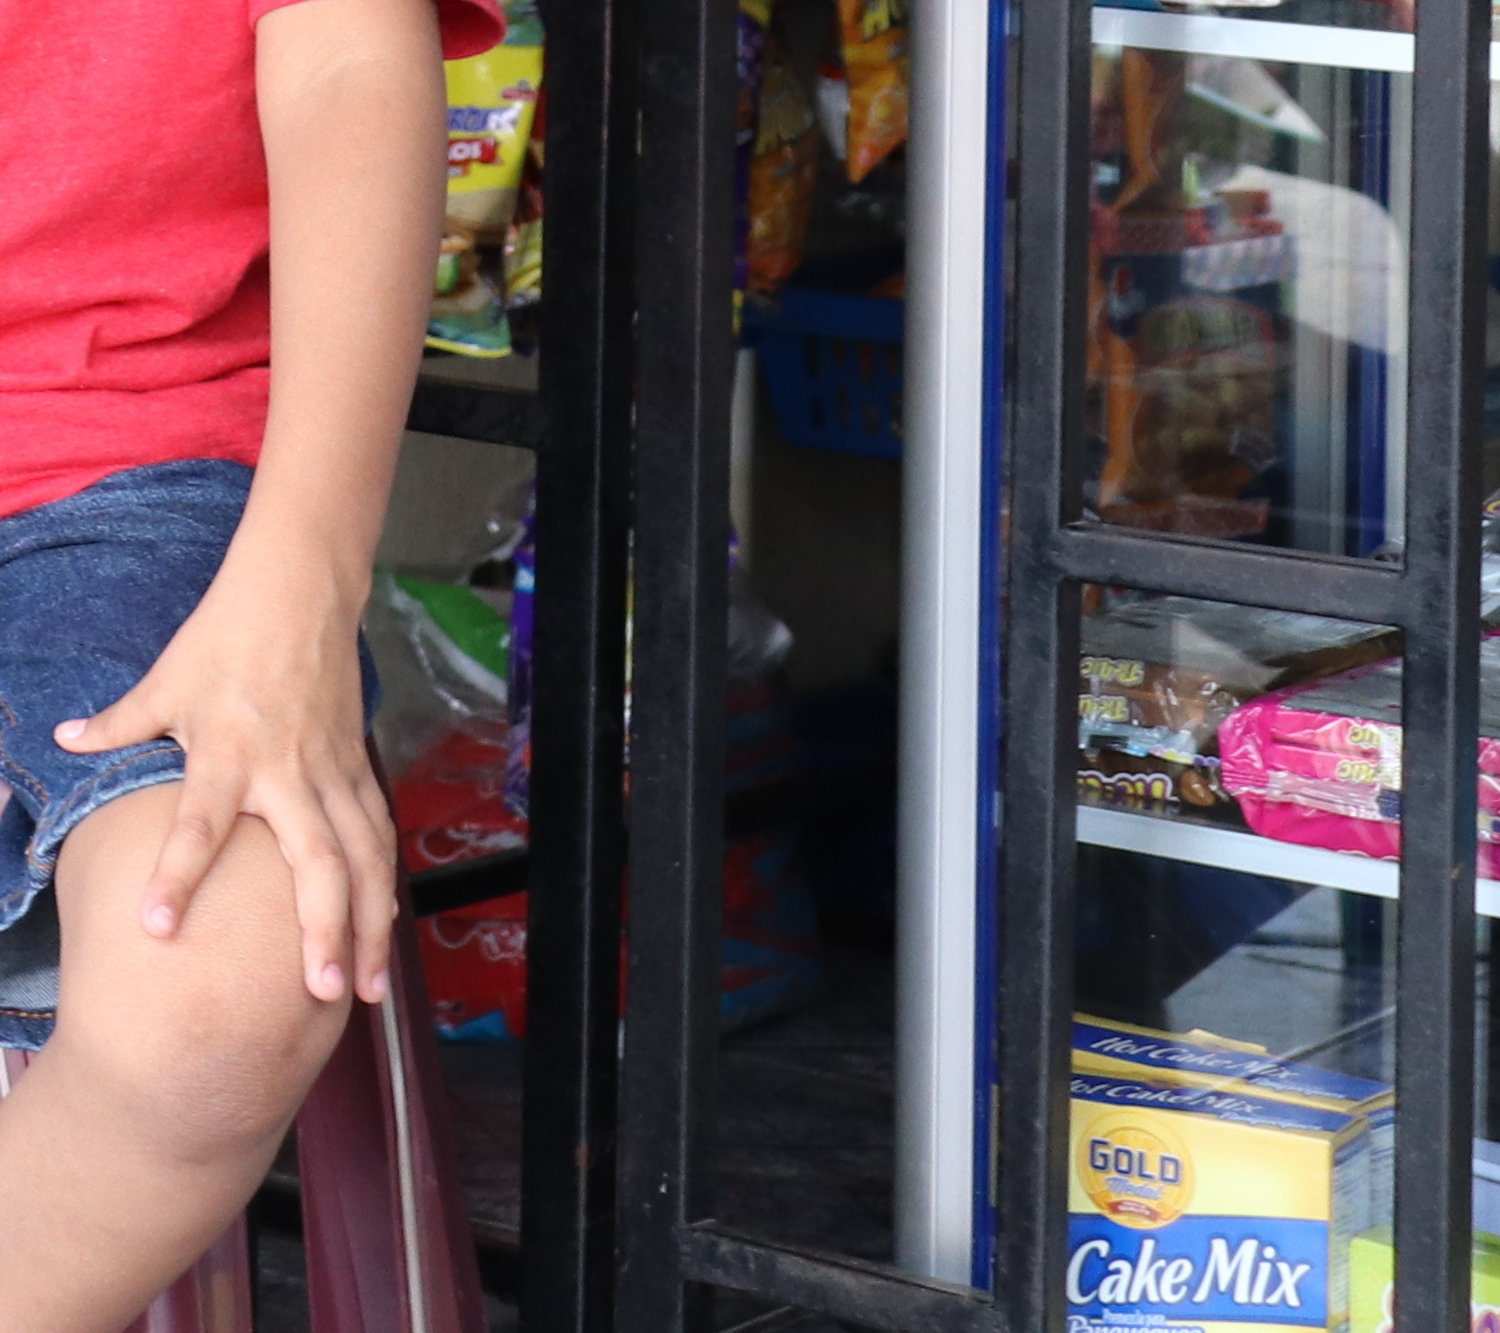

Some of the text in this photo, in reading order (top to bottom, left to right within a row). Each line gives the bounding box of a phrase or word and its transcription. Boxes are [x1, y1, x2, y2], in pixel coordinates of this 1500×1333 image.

[1091, 1036, 1298, 1080] Hot Cake Mix
[1108, 1085, 1182, 1105] Cake
[1191, 1092, 1263, 1115] Mix
[1090, 1139, 1181, 1184] GOLD
[1067, 1237, 1311, 1307] Cake Mix
